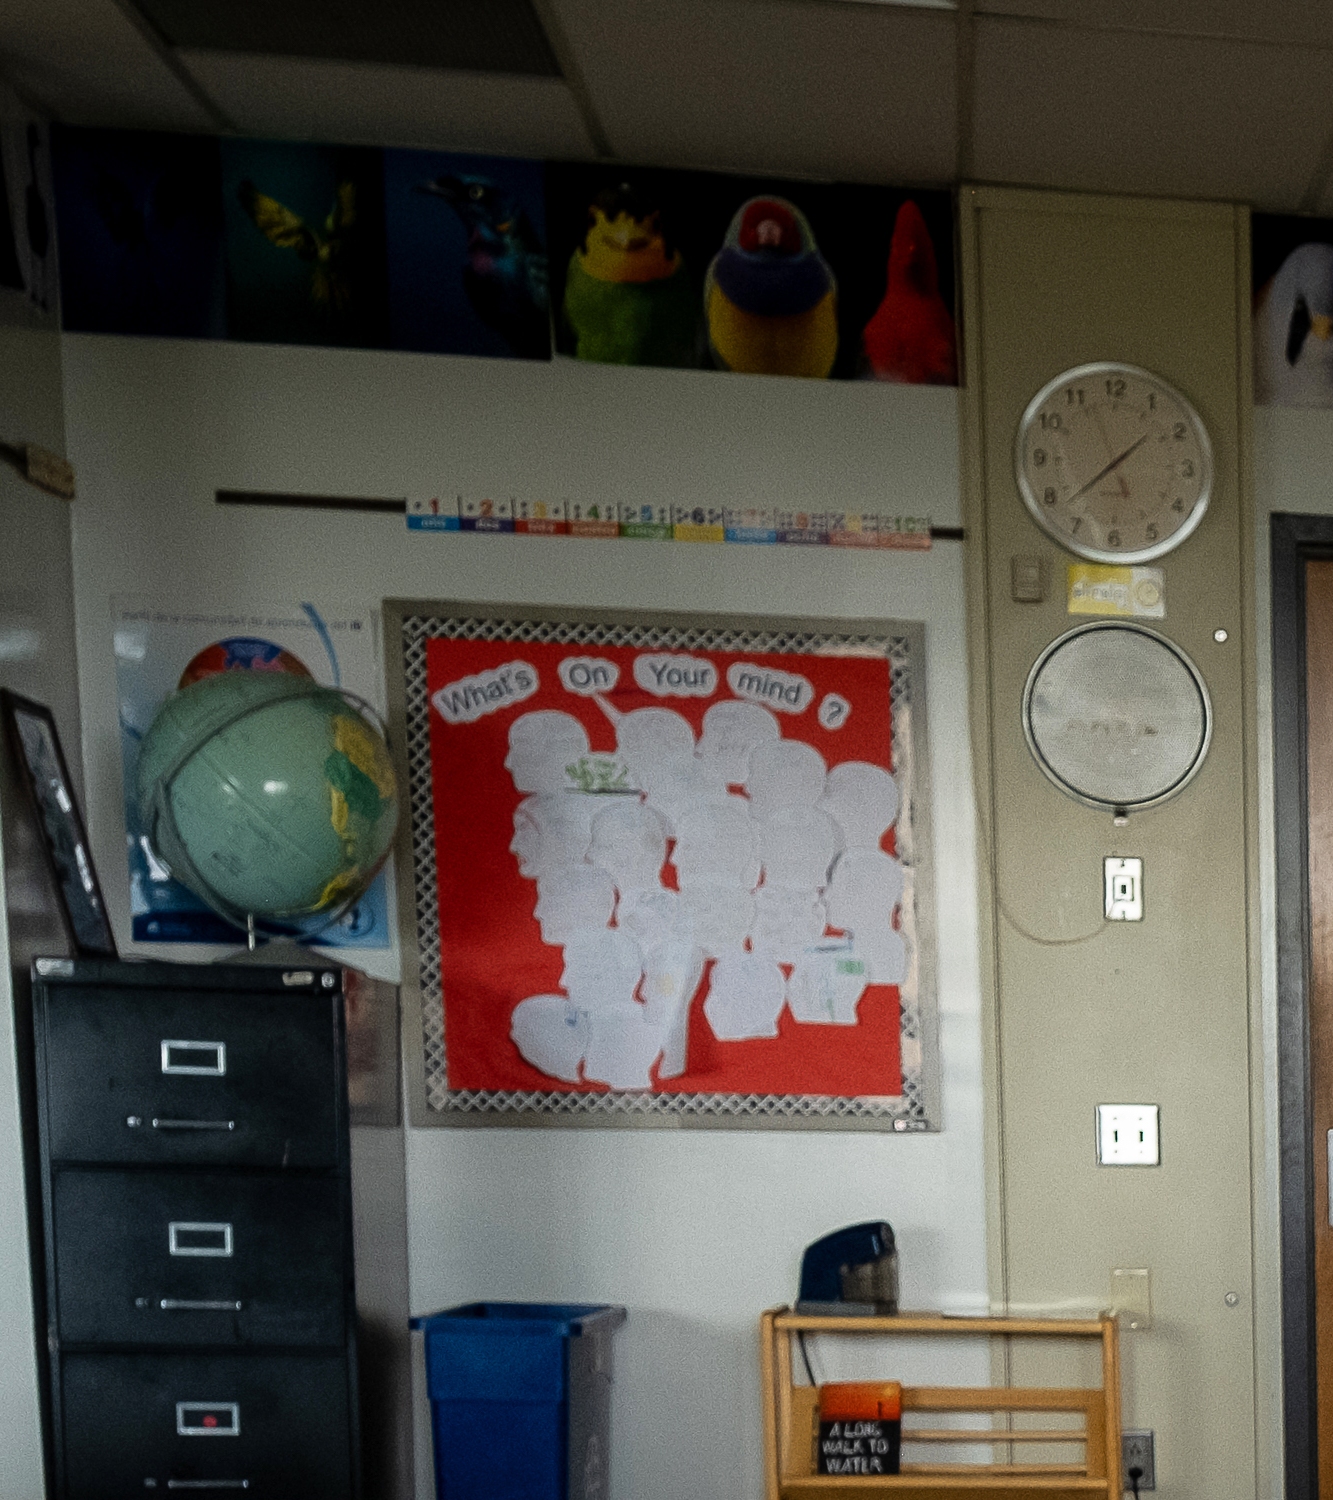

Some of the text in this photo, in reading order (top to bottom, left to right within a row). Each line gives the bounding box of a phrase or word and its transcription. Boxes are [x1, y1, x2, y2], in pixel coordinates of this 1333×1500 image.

[1066, 388, 1084, 405] 11
[1106, 379, 1127, 398] 12
[1149, 392, 1157, 411] 1
[1039, 412, 1063, 430] 10
[1173, 422, 1187, 442] 2
[1033, 448, 1047, 469] 9
[1182, 458, 1195, 478] 3
[1044, 486, 1056, 508] 8
[1171, 497, 1185, 514] 4
[1070, 516, 1083, 535] 7
[1146, 522, 1159, 541] 5
[1107, 529, 1121, 547] 6
[440, 662, 844, 723] What's On Your mind ?
[829, 1421, 882, 1438] A LONG
[822, 1438, 889, 1455] WALK TO
[826, 1455, 883, 1474] WATER
